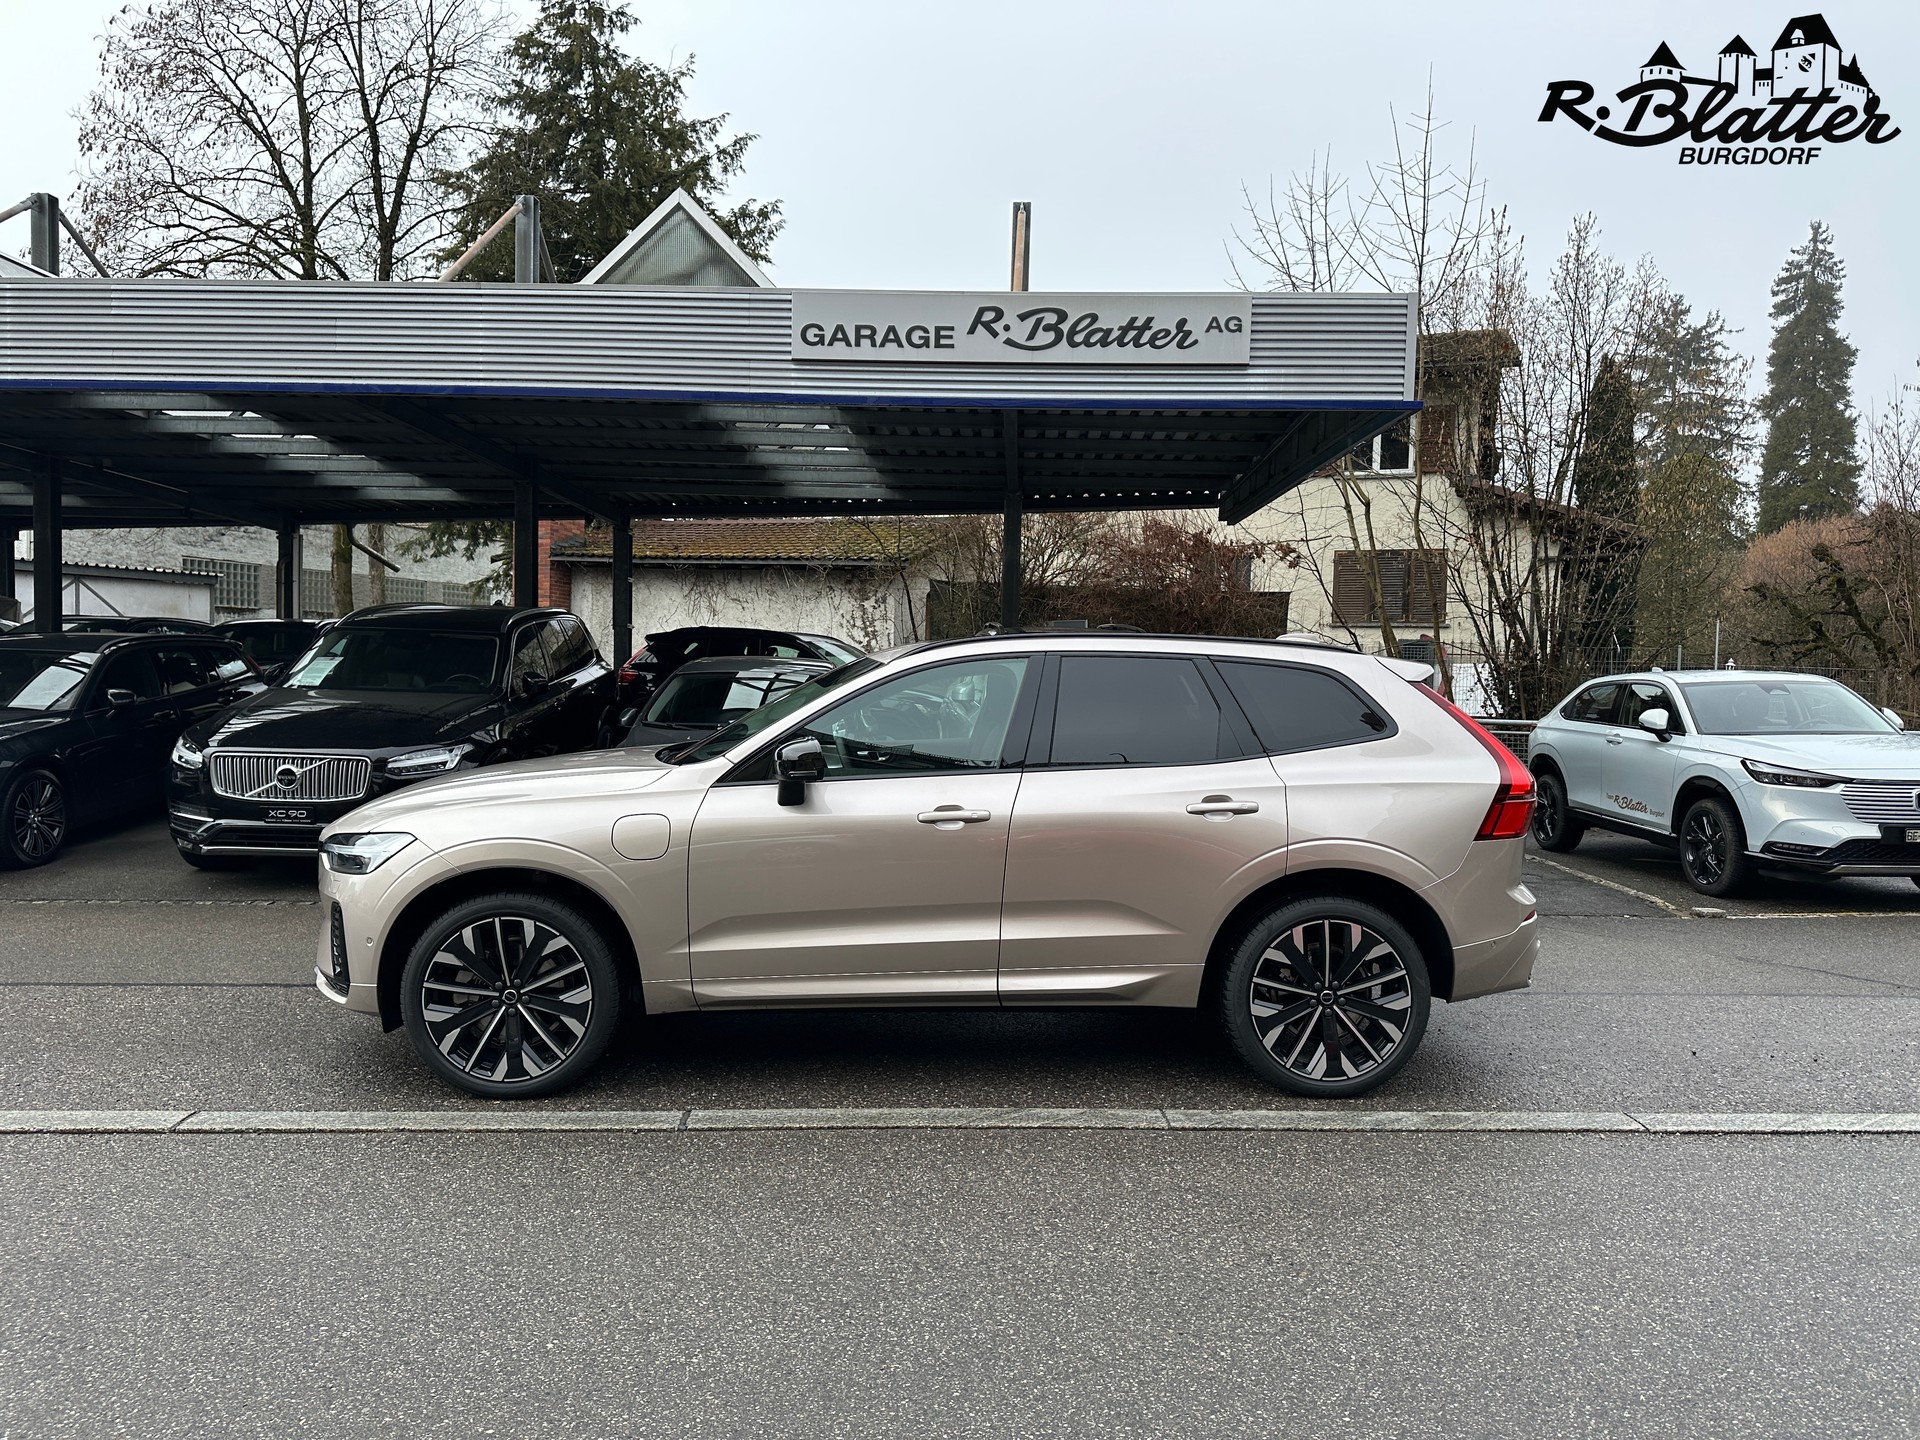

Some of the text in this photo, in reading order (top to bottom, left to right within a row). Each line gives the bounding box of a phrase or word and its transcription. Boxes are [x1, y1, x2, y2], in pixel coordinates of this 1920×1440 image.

[799, 323, 955, 350] GARAGE
[1002, 306, 1200, 352] Blatter
[1204, 316, 1243, 334] AG
